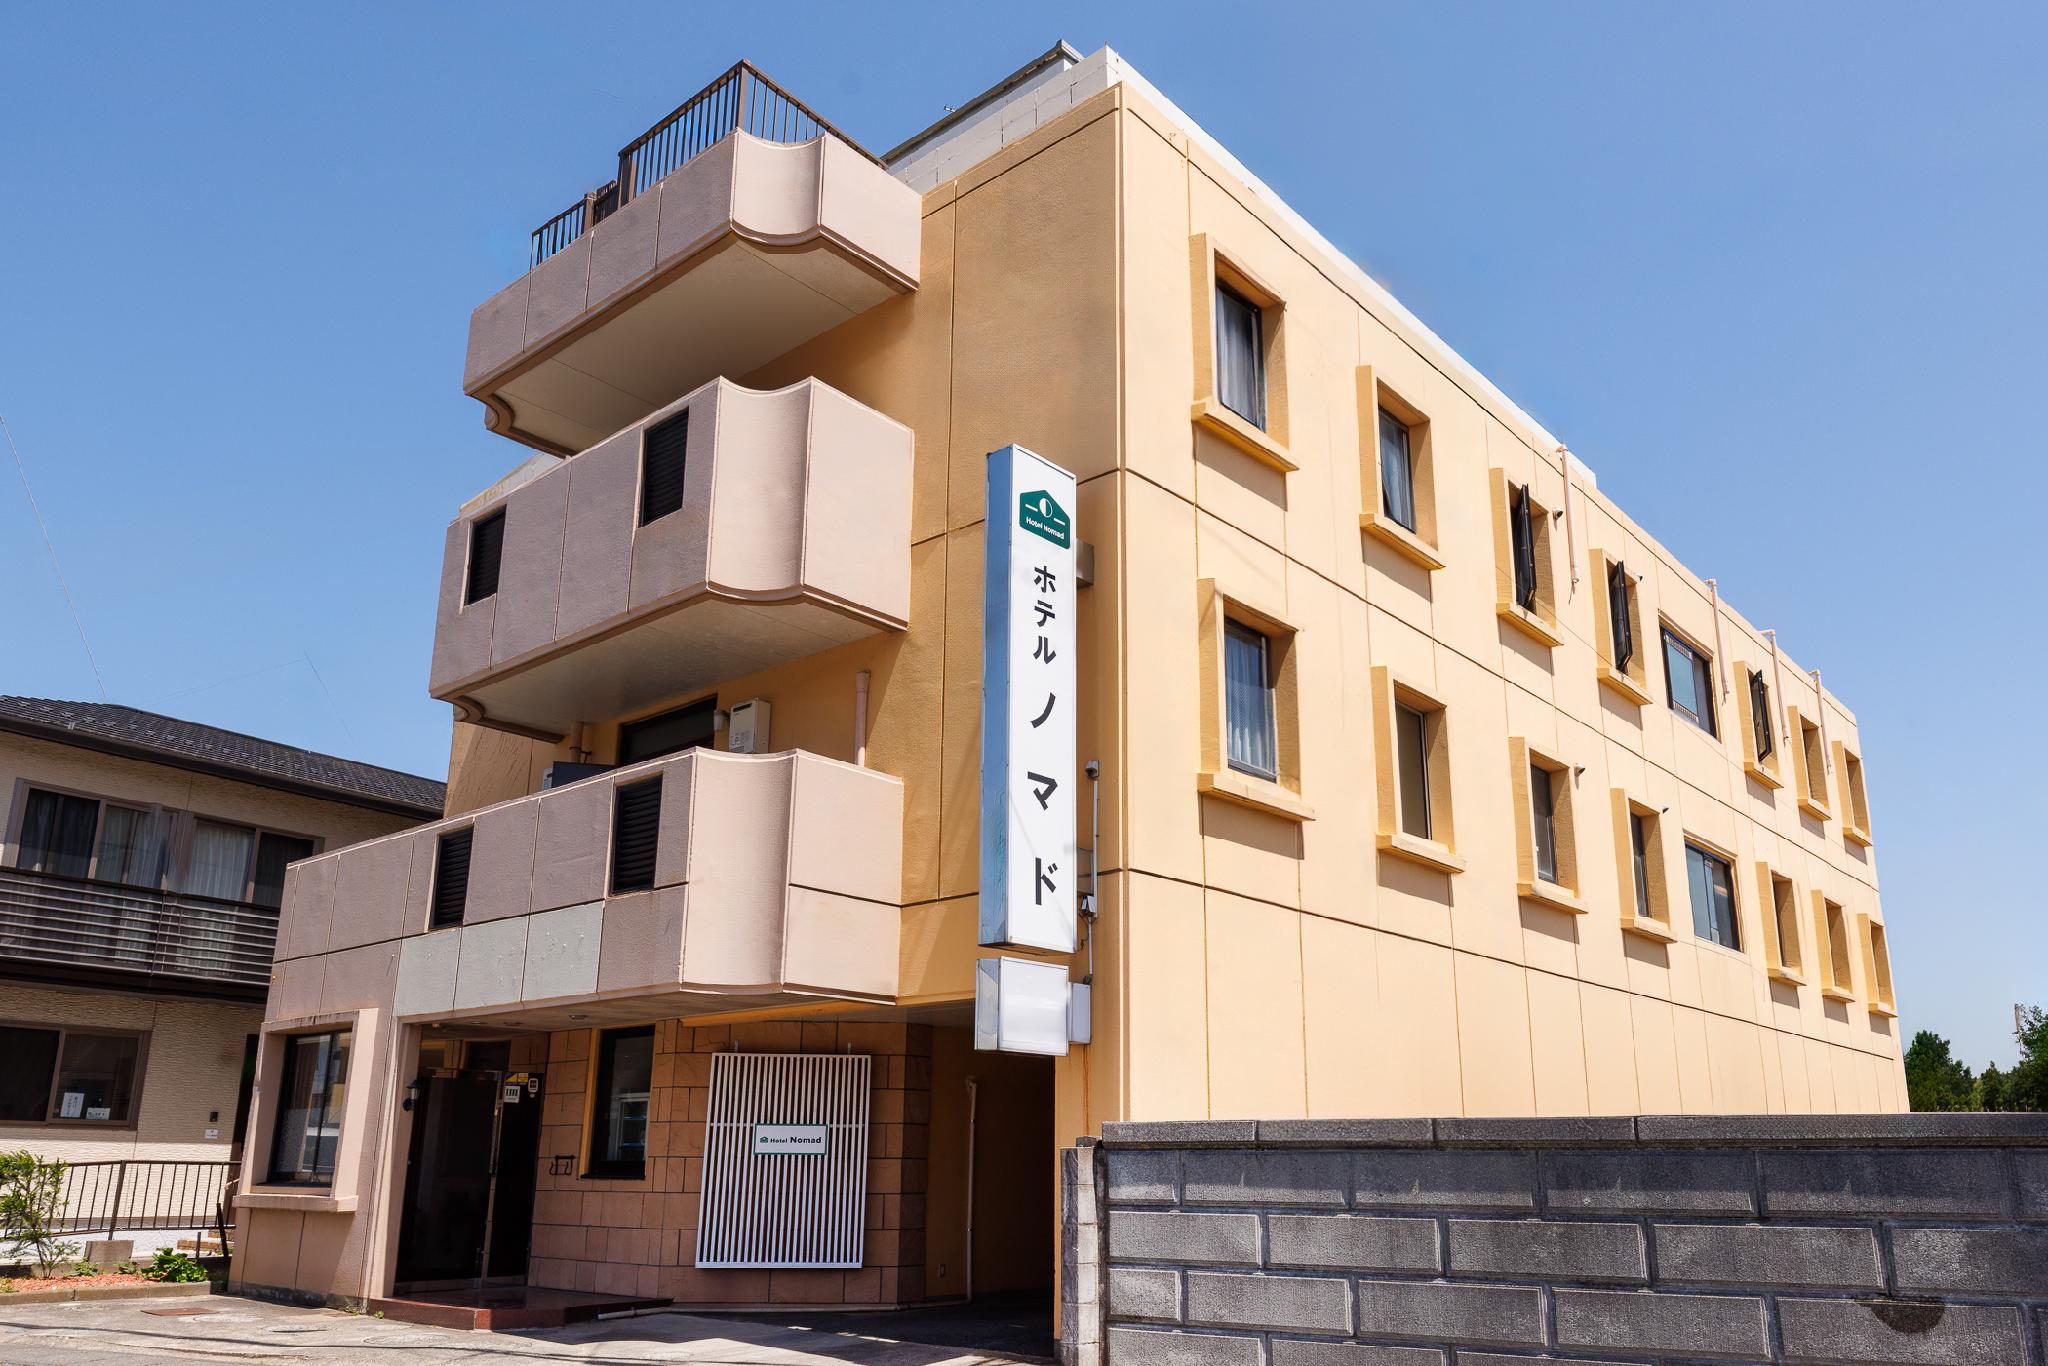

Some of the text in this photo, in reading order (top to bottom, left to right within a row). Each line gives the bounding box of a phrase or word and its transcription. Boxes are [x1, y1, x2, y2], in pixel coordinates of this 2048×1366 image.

[1026, 516, 1043, 528] Hotel
[1027, 565, 1058, 906] ホテル ノマド
